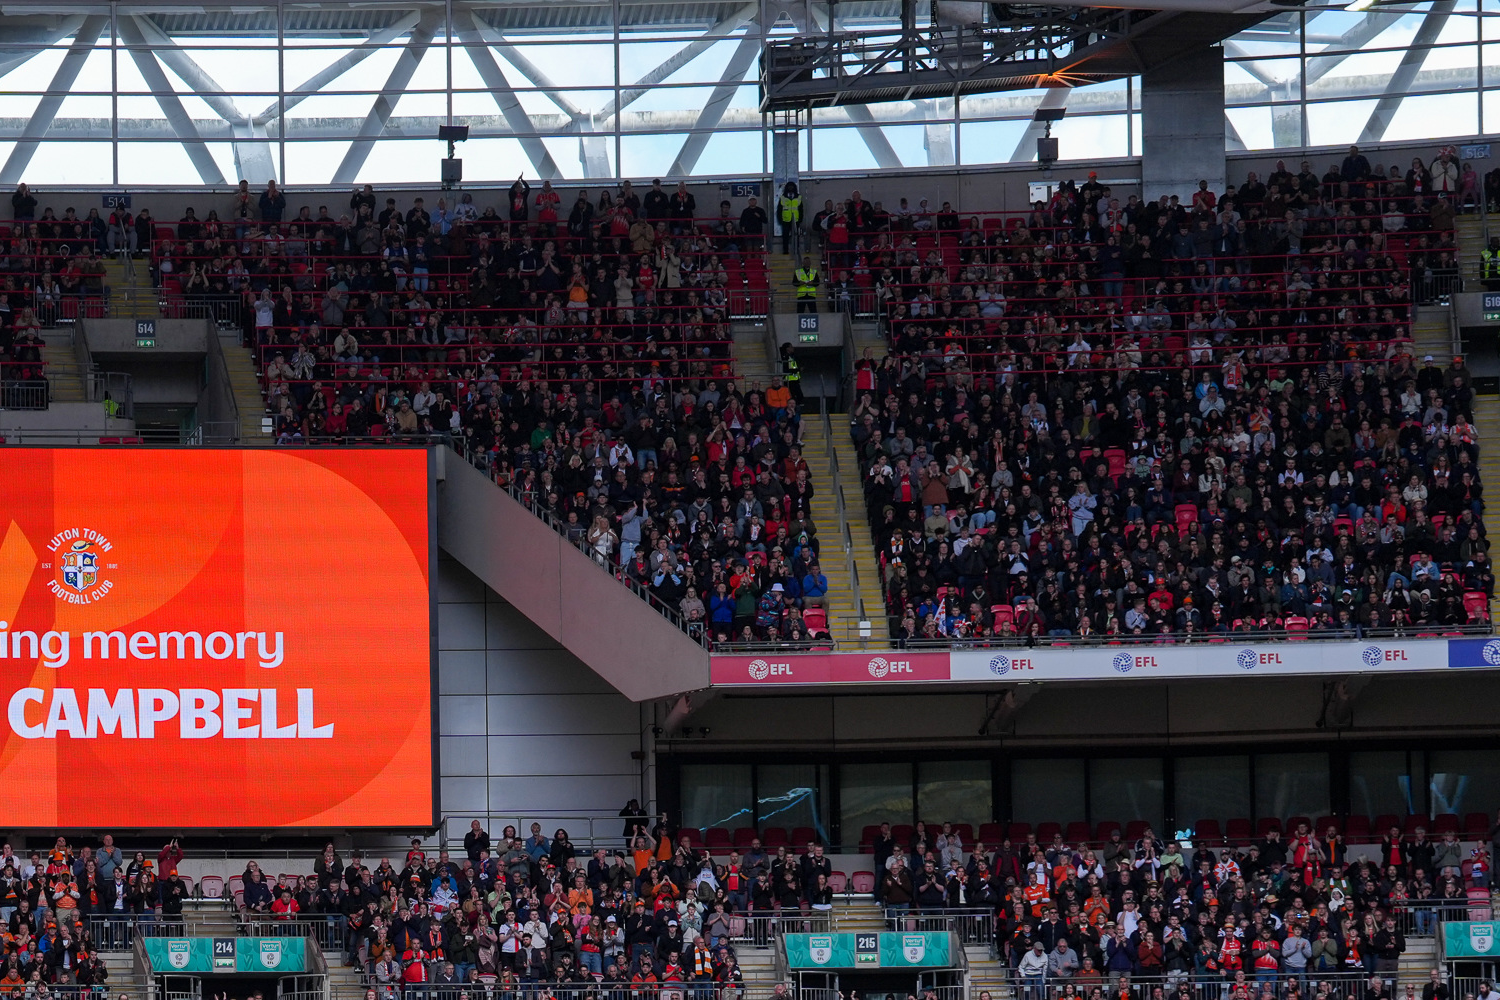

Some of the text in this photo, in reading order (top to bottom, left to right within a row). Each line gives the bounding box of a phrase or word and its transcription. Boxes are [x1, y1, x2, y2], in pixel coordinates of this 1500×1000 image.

[1466, 148, 1484, 158] 516
[736, 185, 754, 196] 515
[1485, 297, 1500, 307] 516
[137, 323, 154, 334] 514
[800, 318, 817, 328] 515
[46, 528, 113, 552] LUTON TOWN
[47, 579, 113, 605] FOOTBALL CLUB
[83, 631, 284, 668] memory
[1260, 653, 1282, 664] EFL
[1385, 650, 1408, 661] EFL
[889, 661, 913, 673] EFL
[1011, 659, 1034, 670] EFL
[1135, 656, 1157, 667] EFL
[770, 664, 793, 675] EFL
[7, 687, 334, 739] CAMPBELL
[216, 942, 233, 953] 214
[858, 938, 876, 949] 215
